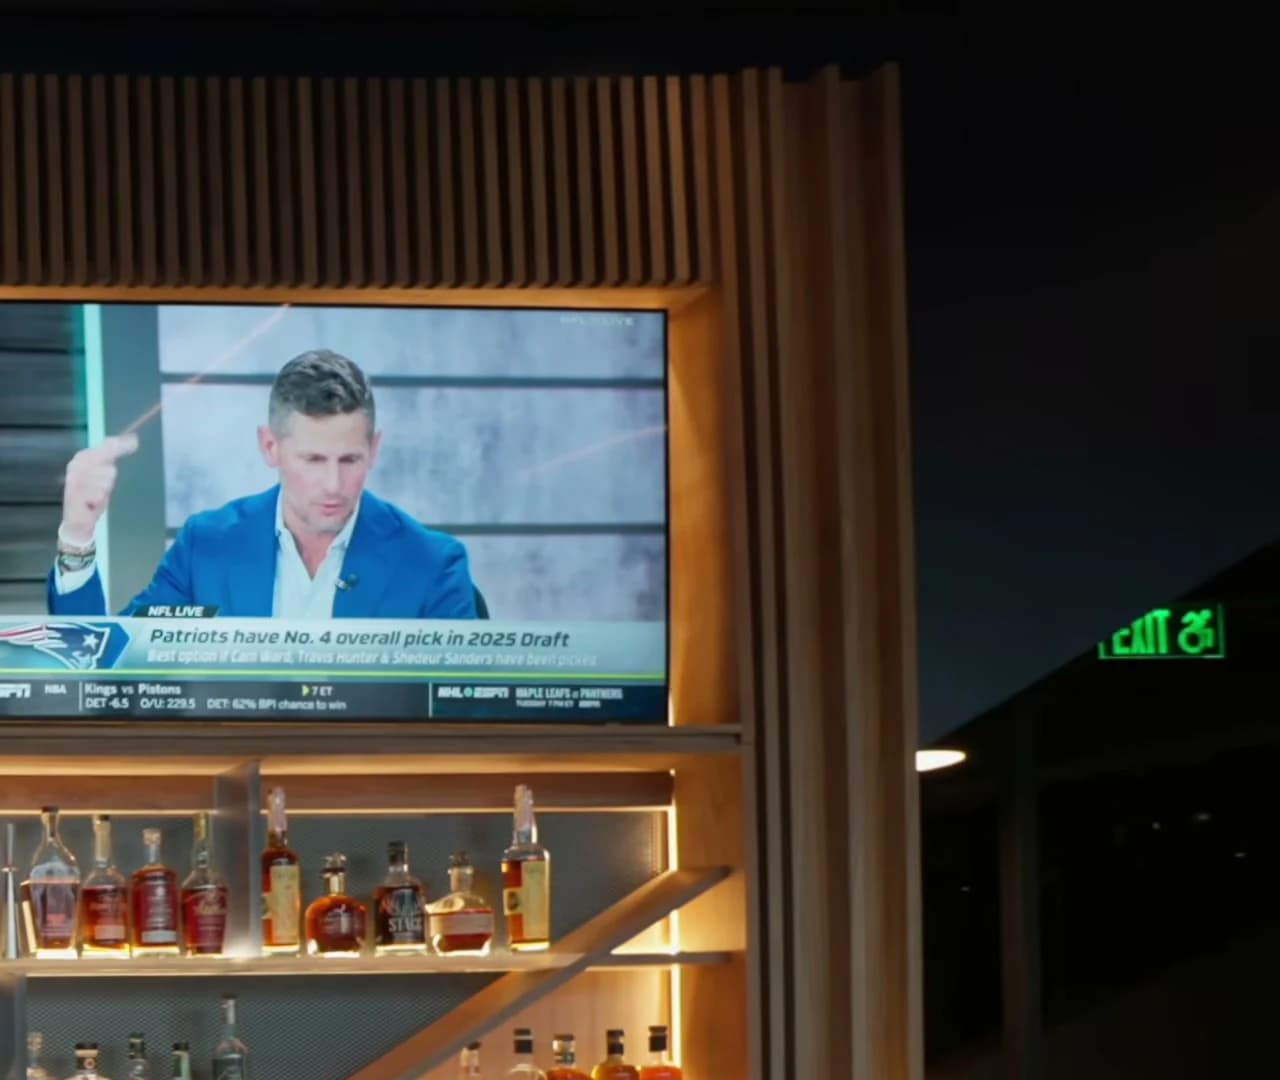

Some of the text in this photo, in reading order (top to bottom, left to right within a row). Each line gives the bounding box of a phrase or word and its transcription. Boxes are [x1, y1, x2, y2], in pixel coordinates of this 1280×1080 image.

[147, 606, 204, 617] NFL LIVE
[149, 627, 571, 648] Patriots have No. 4 overall pick in 2025 Draft
[84, 683, 182, 696] Kings vs Pistons
[85, 698, 107, 710] DET
